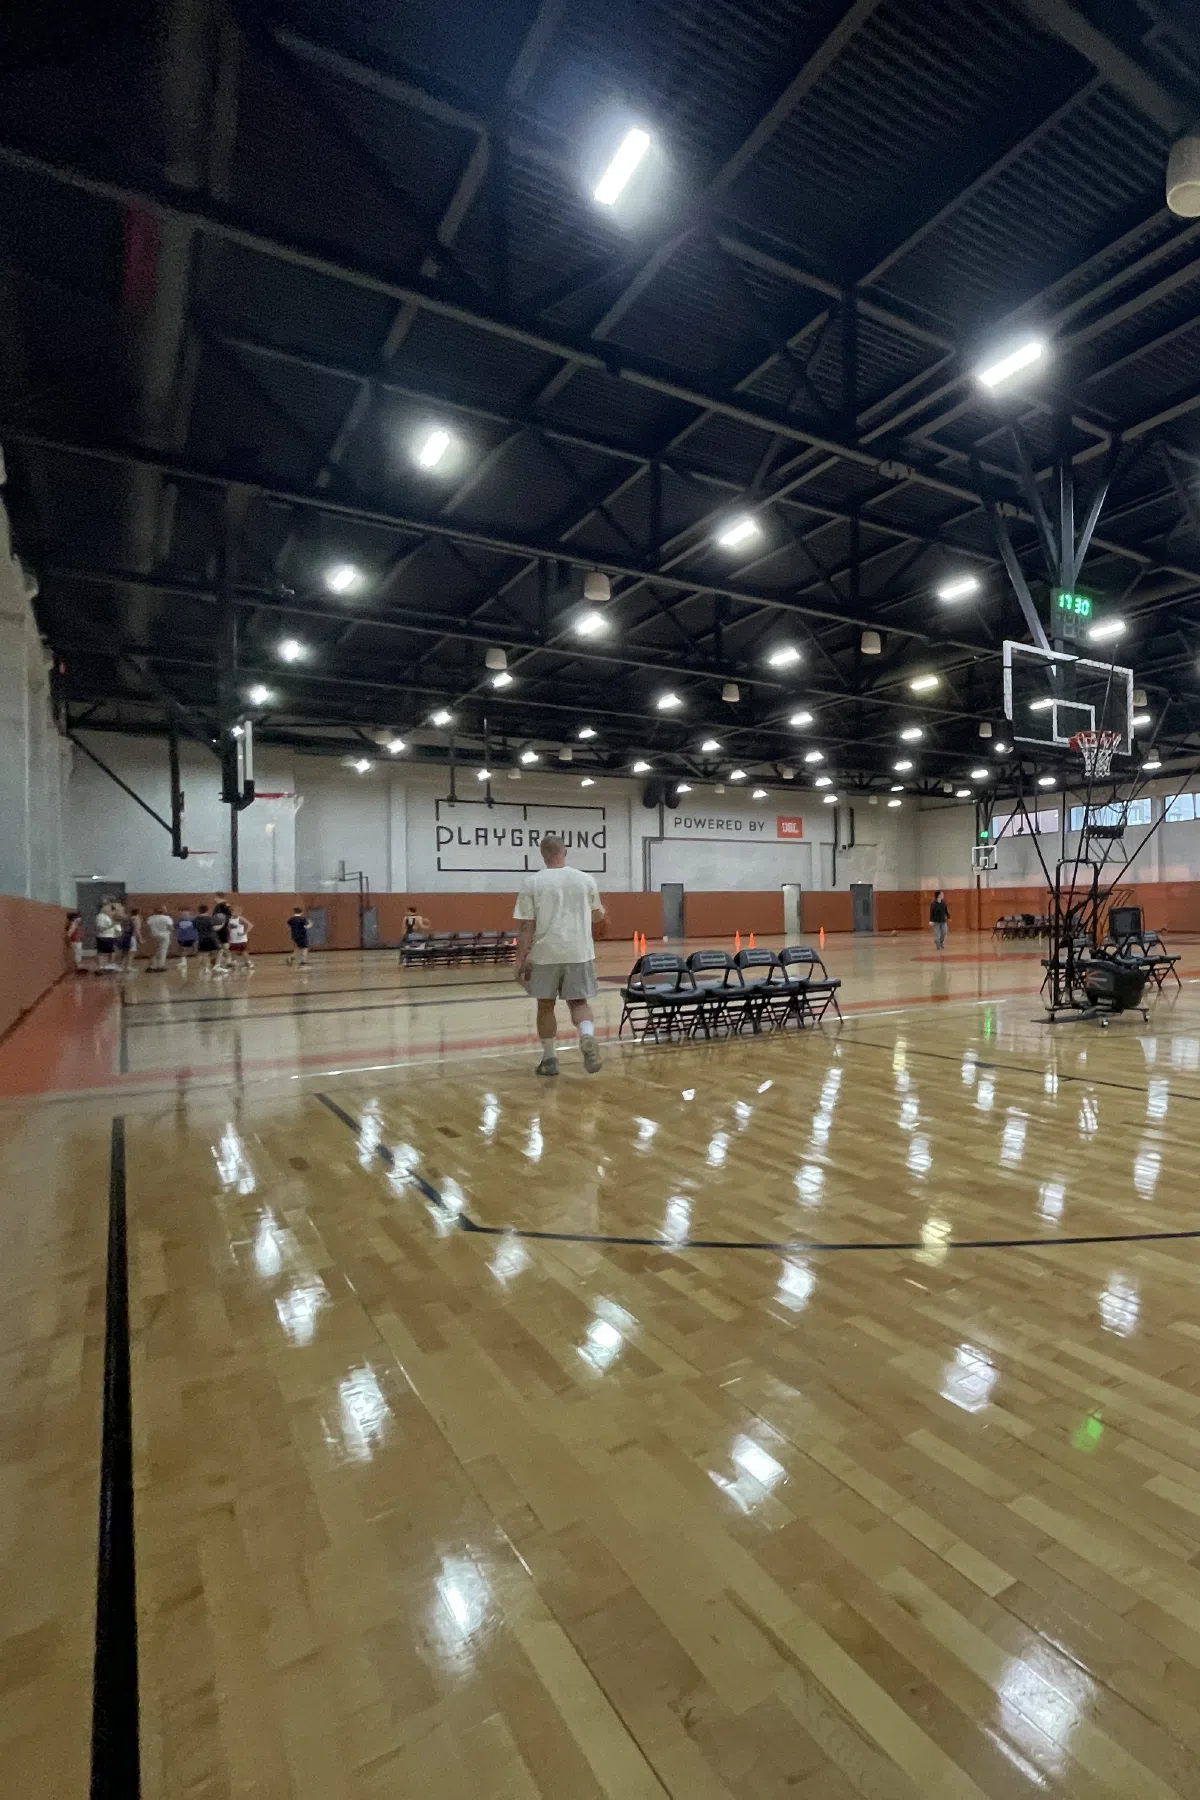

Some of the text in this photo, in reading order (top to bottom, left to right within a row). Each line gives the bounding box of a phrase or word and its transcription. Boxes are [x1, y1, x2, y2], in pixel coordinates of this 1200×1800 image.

[674, 817, 799, 834] POWERED BY JBL
